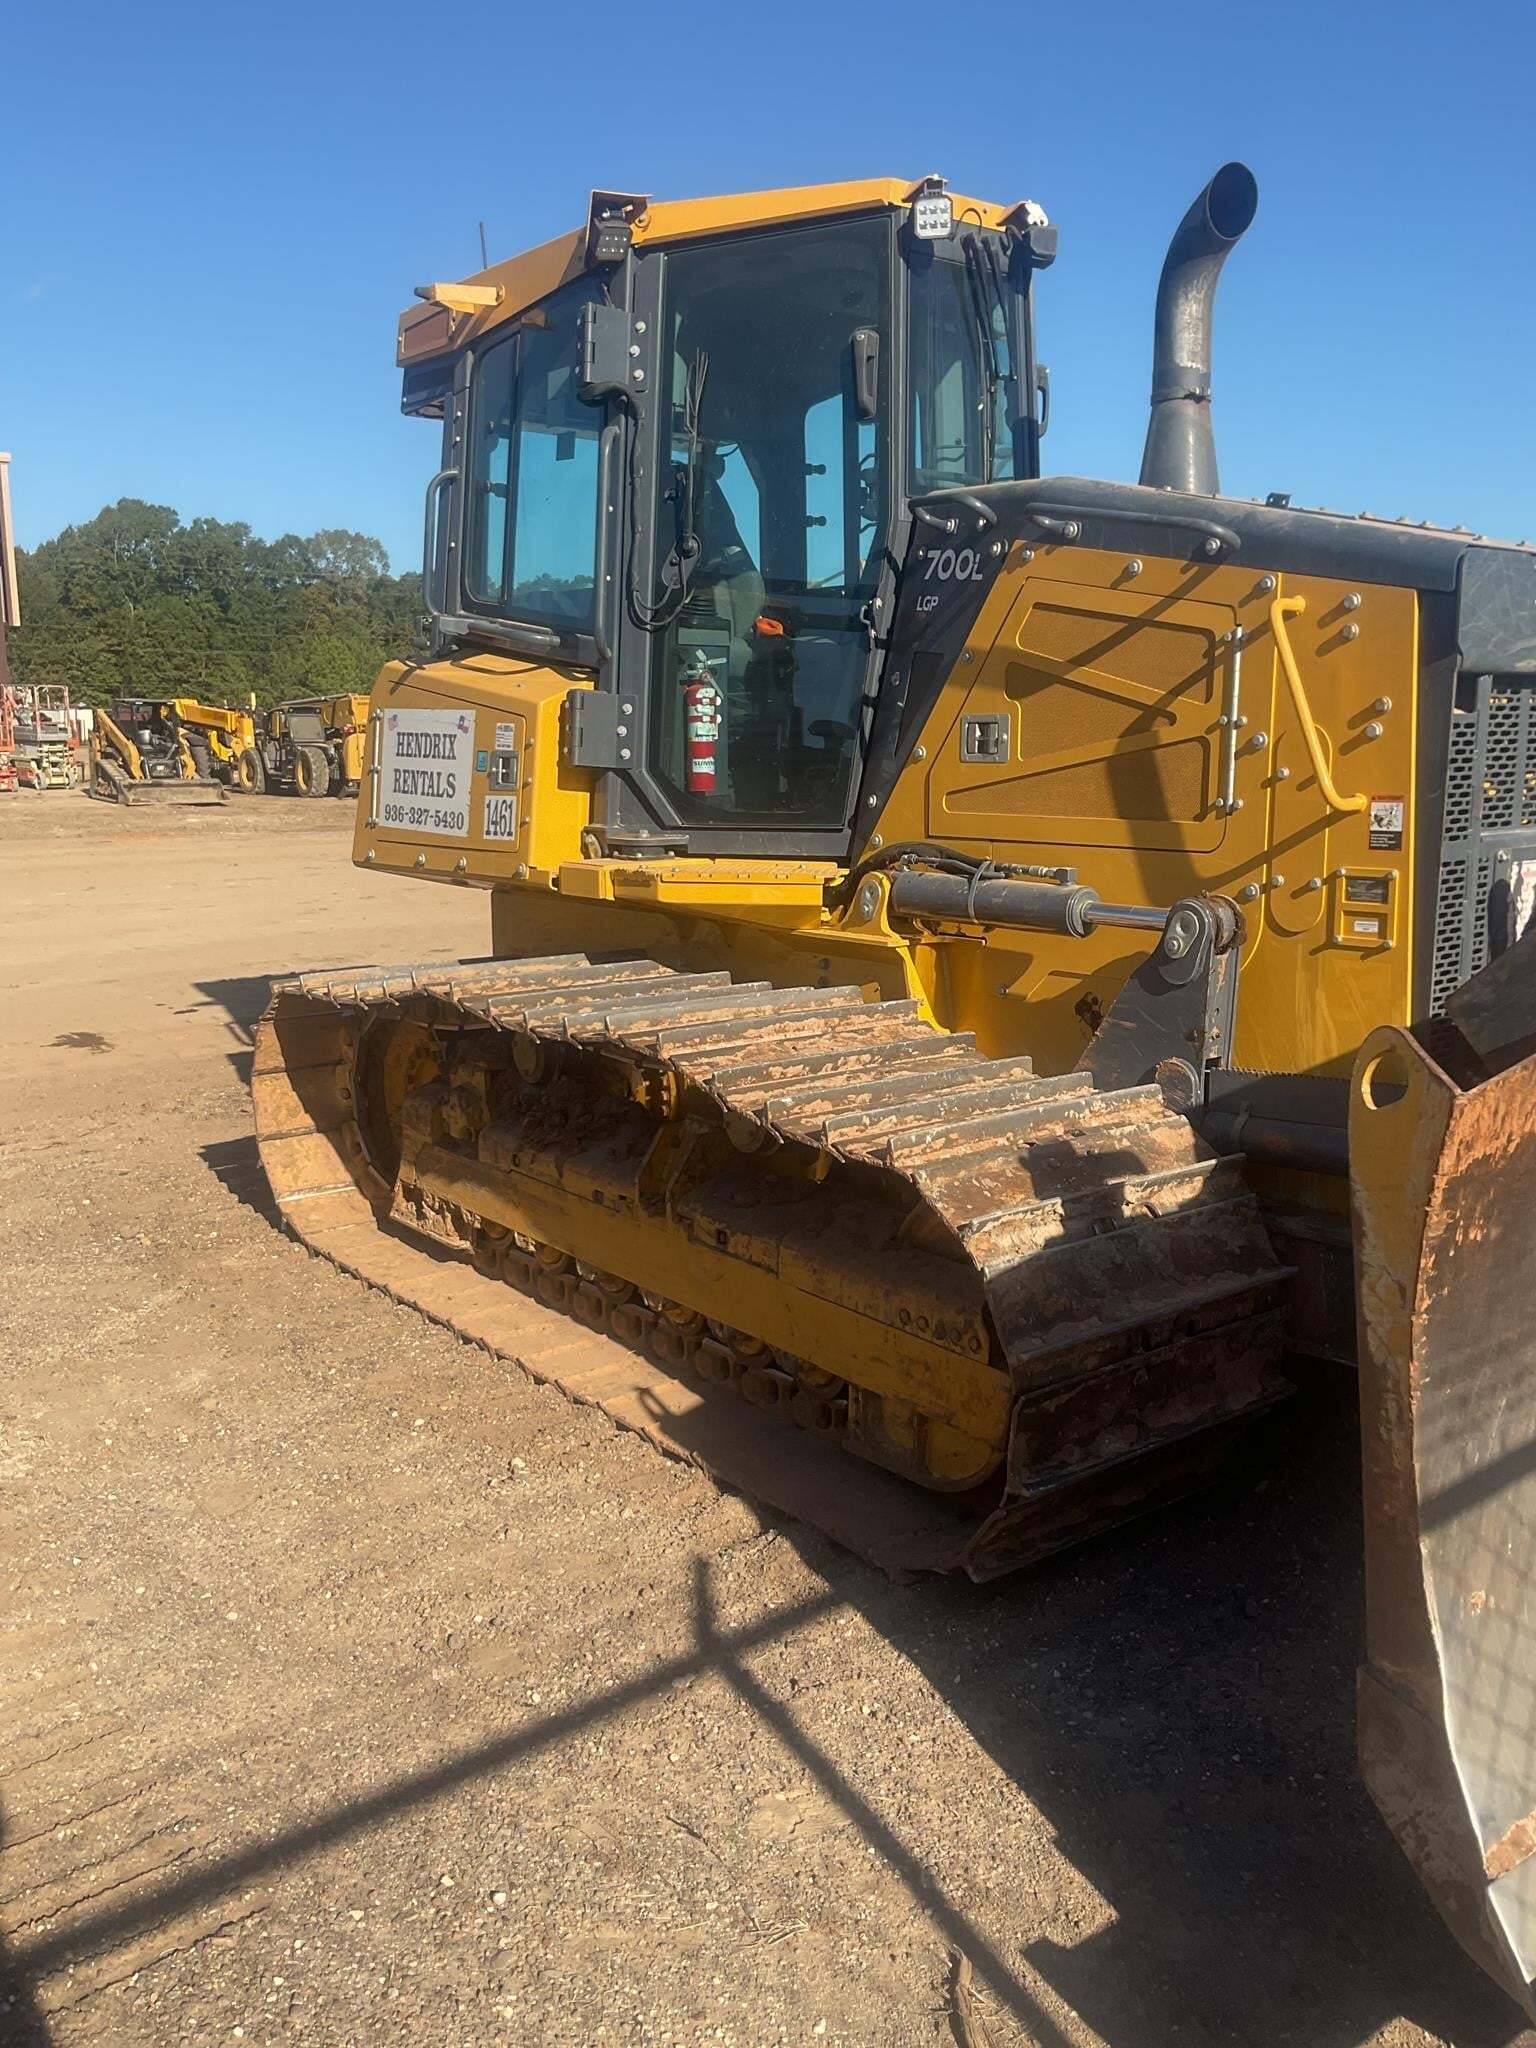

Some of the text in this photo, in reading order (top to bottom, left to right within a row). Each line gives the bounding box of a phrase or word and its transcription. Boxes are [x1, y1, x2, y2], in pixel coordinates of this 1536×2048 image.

[923, 549, 983, 580] 700L
[916, 595, 939, 611] LGP
[396, 731, 457, 760] HENDRIX
[393, 768, 456, 799] RENTALS
[384, 803, 465, 830] 936-327-5430
[485, 799, 513, 837] 1461
